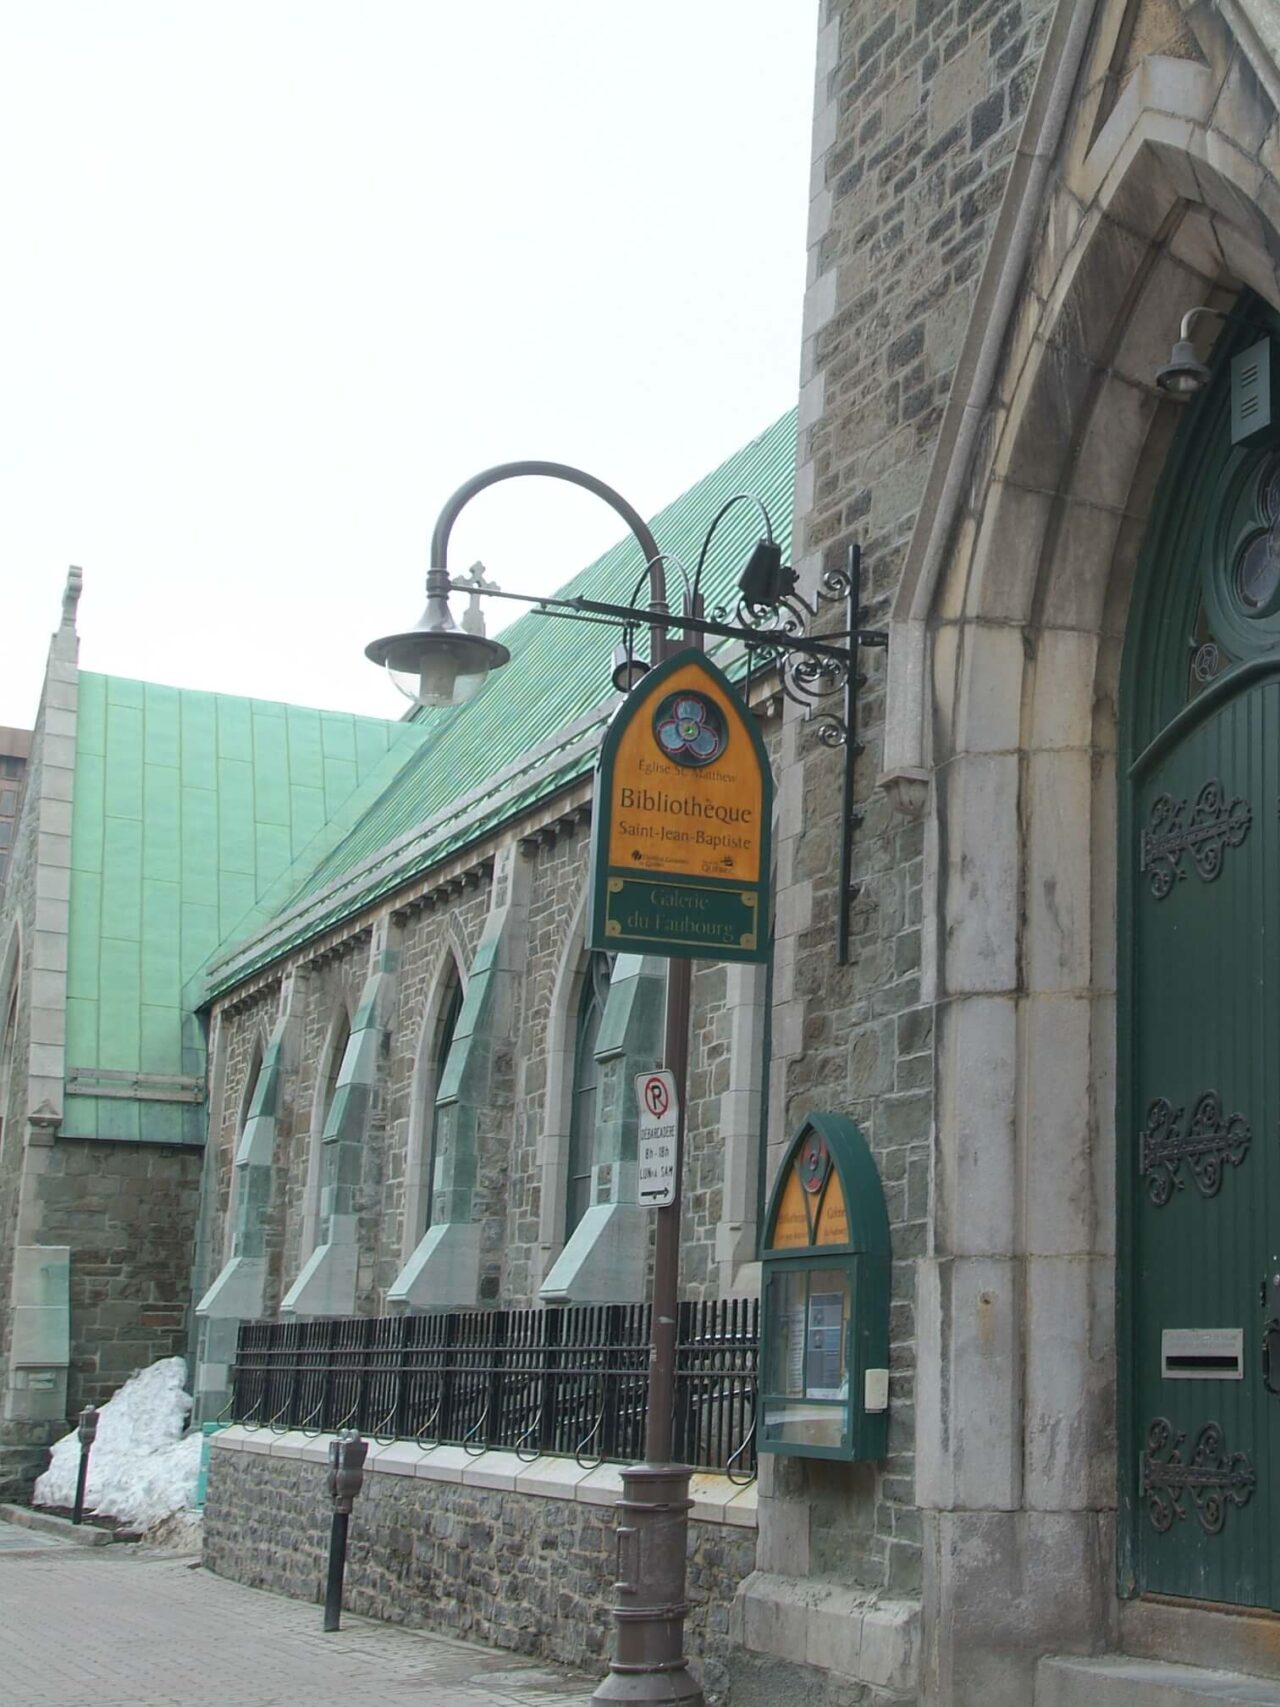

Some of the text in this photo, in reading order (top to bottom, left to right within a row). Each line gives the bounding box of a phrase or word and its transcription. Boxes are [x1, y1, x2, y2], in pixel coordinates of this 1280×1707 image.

[638, 759, 670, 775] Église
[694, 767, 737, 783] Matthew
[621, 788, 752, 824] Bibliothèque
[619, 821, 752, 850] Saint-Jean-Baptiste
[650, 889, 709, 910] Galerie
[627, 911, 734, 943] du Faubourg
